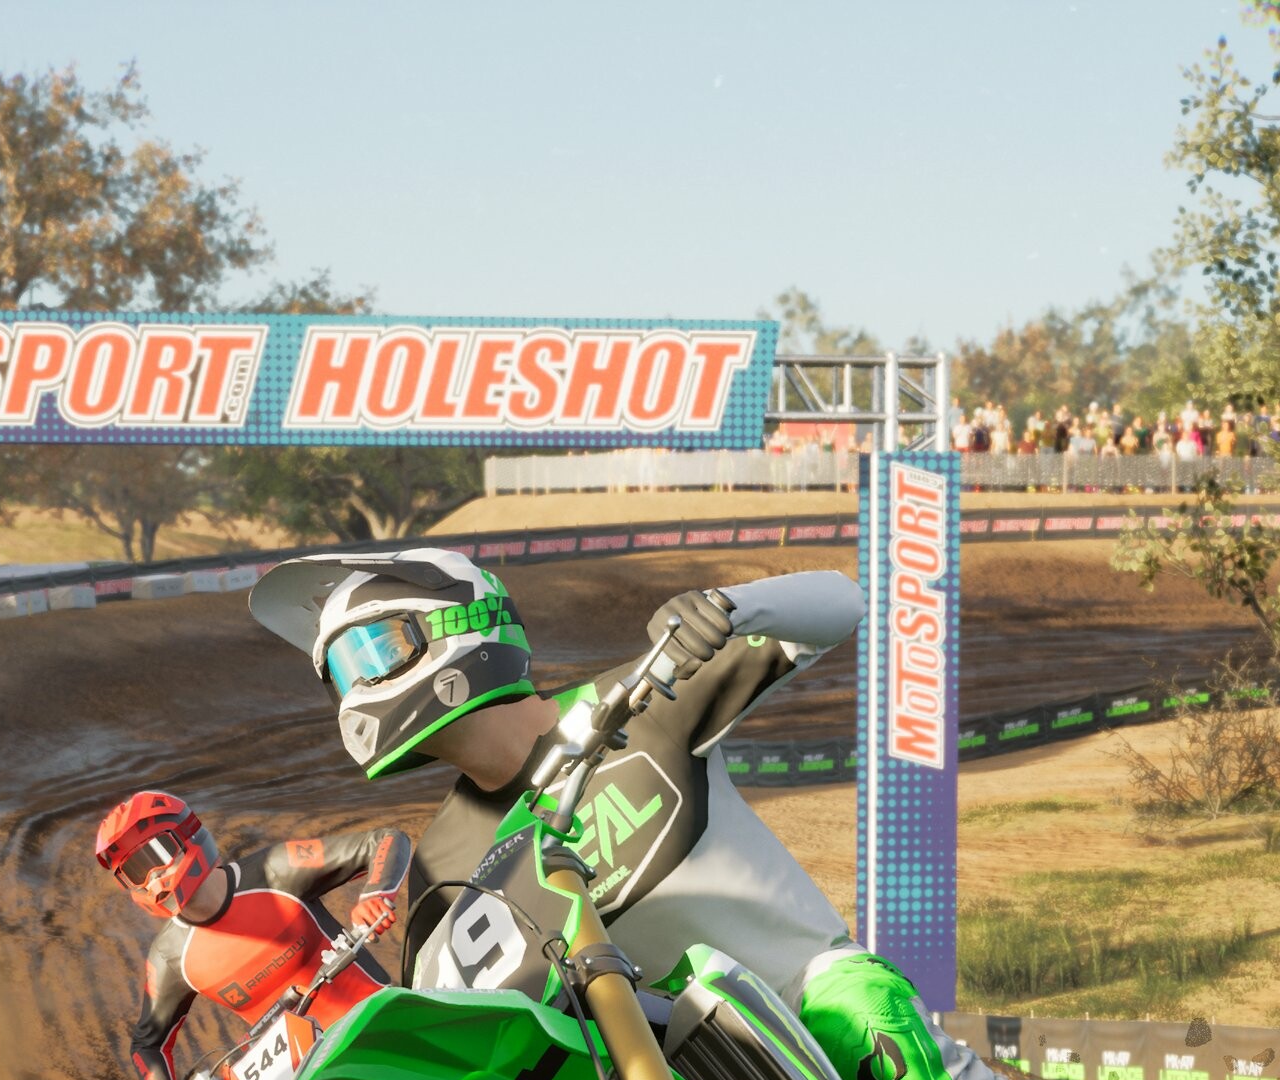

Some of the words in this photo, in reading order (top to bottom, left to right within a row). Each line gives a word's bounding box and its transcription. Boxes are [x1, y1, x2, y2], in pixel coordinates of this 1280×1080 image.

[295, 334, 743, 421] HOLESHOT
[425, 596, 513, 641] 100%
[560, 782, 664, 870] EAL
